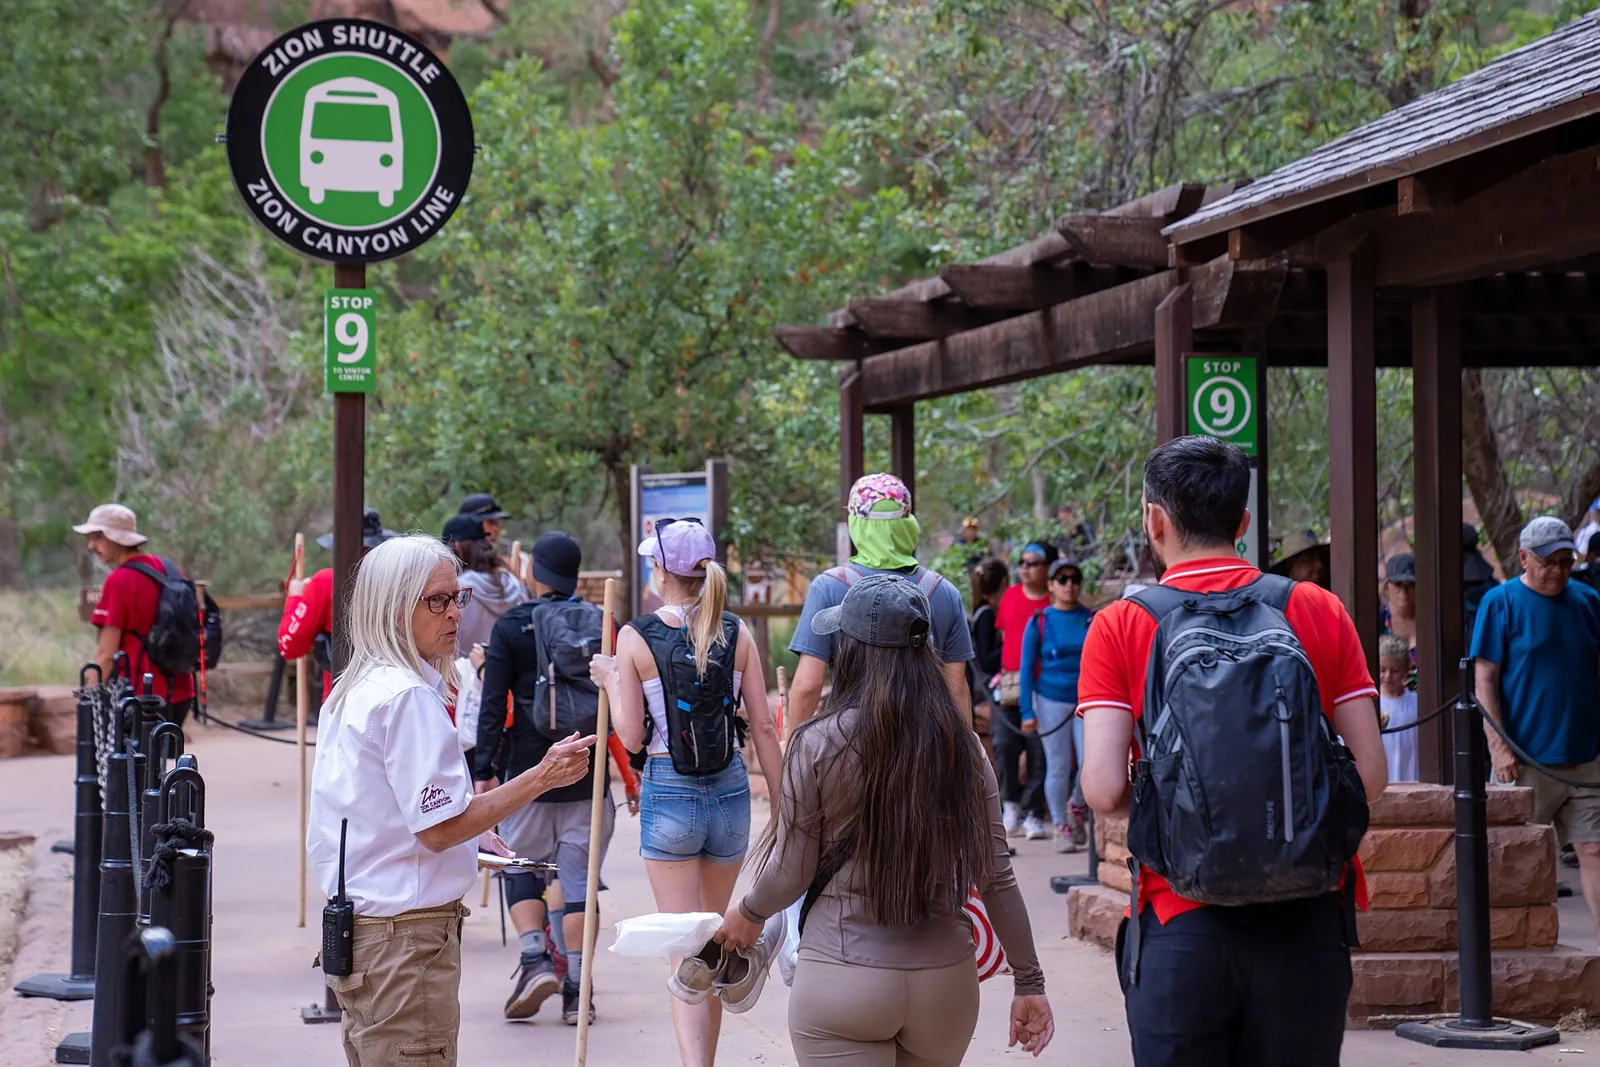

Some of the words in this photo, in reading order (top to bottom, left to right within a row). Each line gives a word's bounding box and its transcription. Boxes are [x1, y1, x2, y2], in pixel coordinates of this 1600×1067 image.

[261, 28, 325, 77] ZION
[332, 24, 441, 84] SHUTTLE
[247, 178, 299, 234] ZION
[302, 226, 409, 255] CANYON
[410, 185, 455, 235] LINE
[331, 296, 373, 309] STOP
[334, 312, 369, 364] 9
[332, 366, 342, 374] TO
[1203, 361, 1241, 374] STOP
[1210, 387, 1235, 427] 9
[420, 784, 446, 805] Zion
